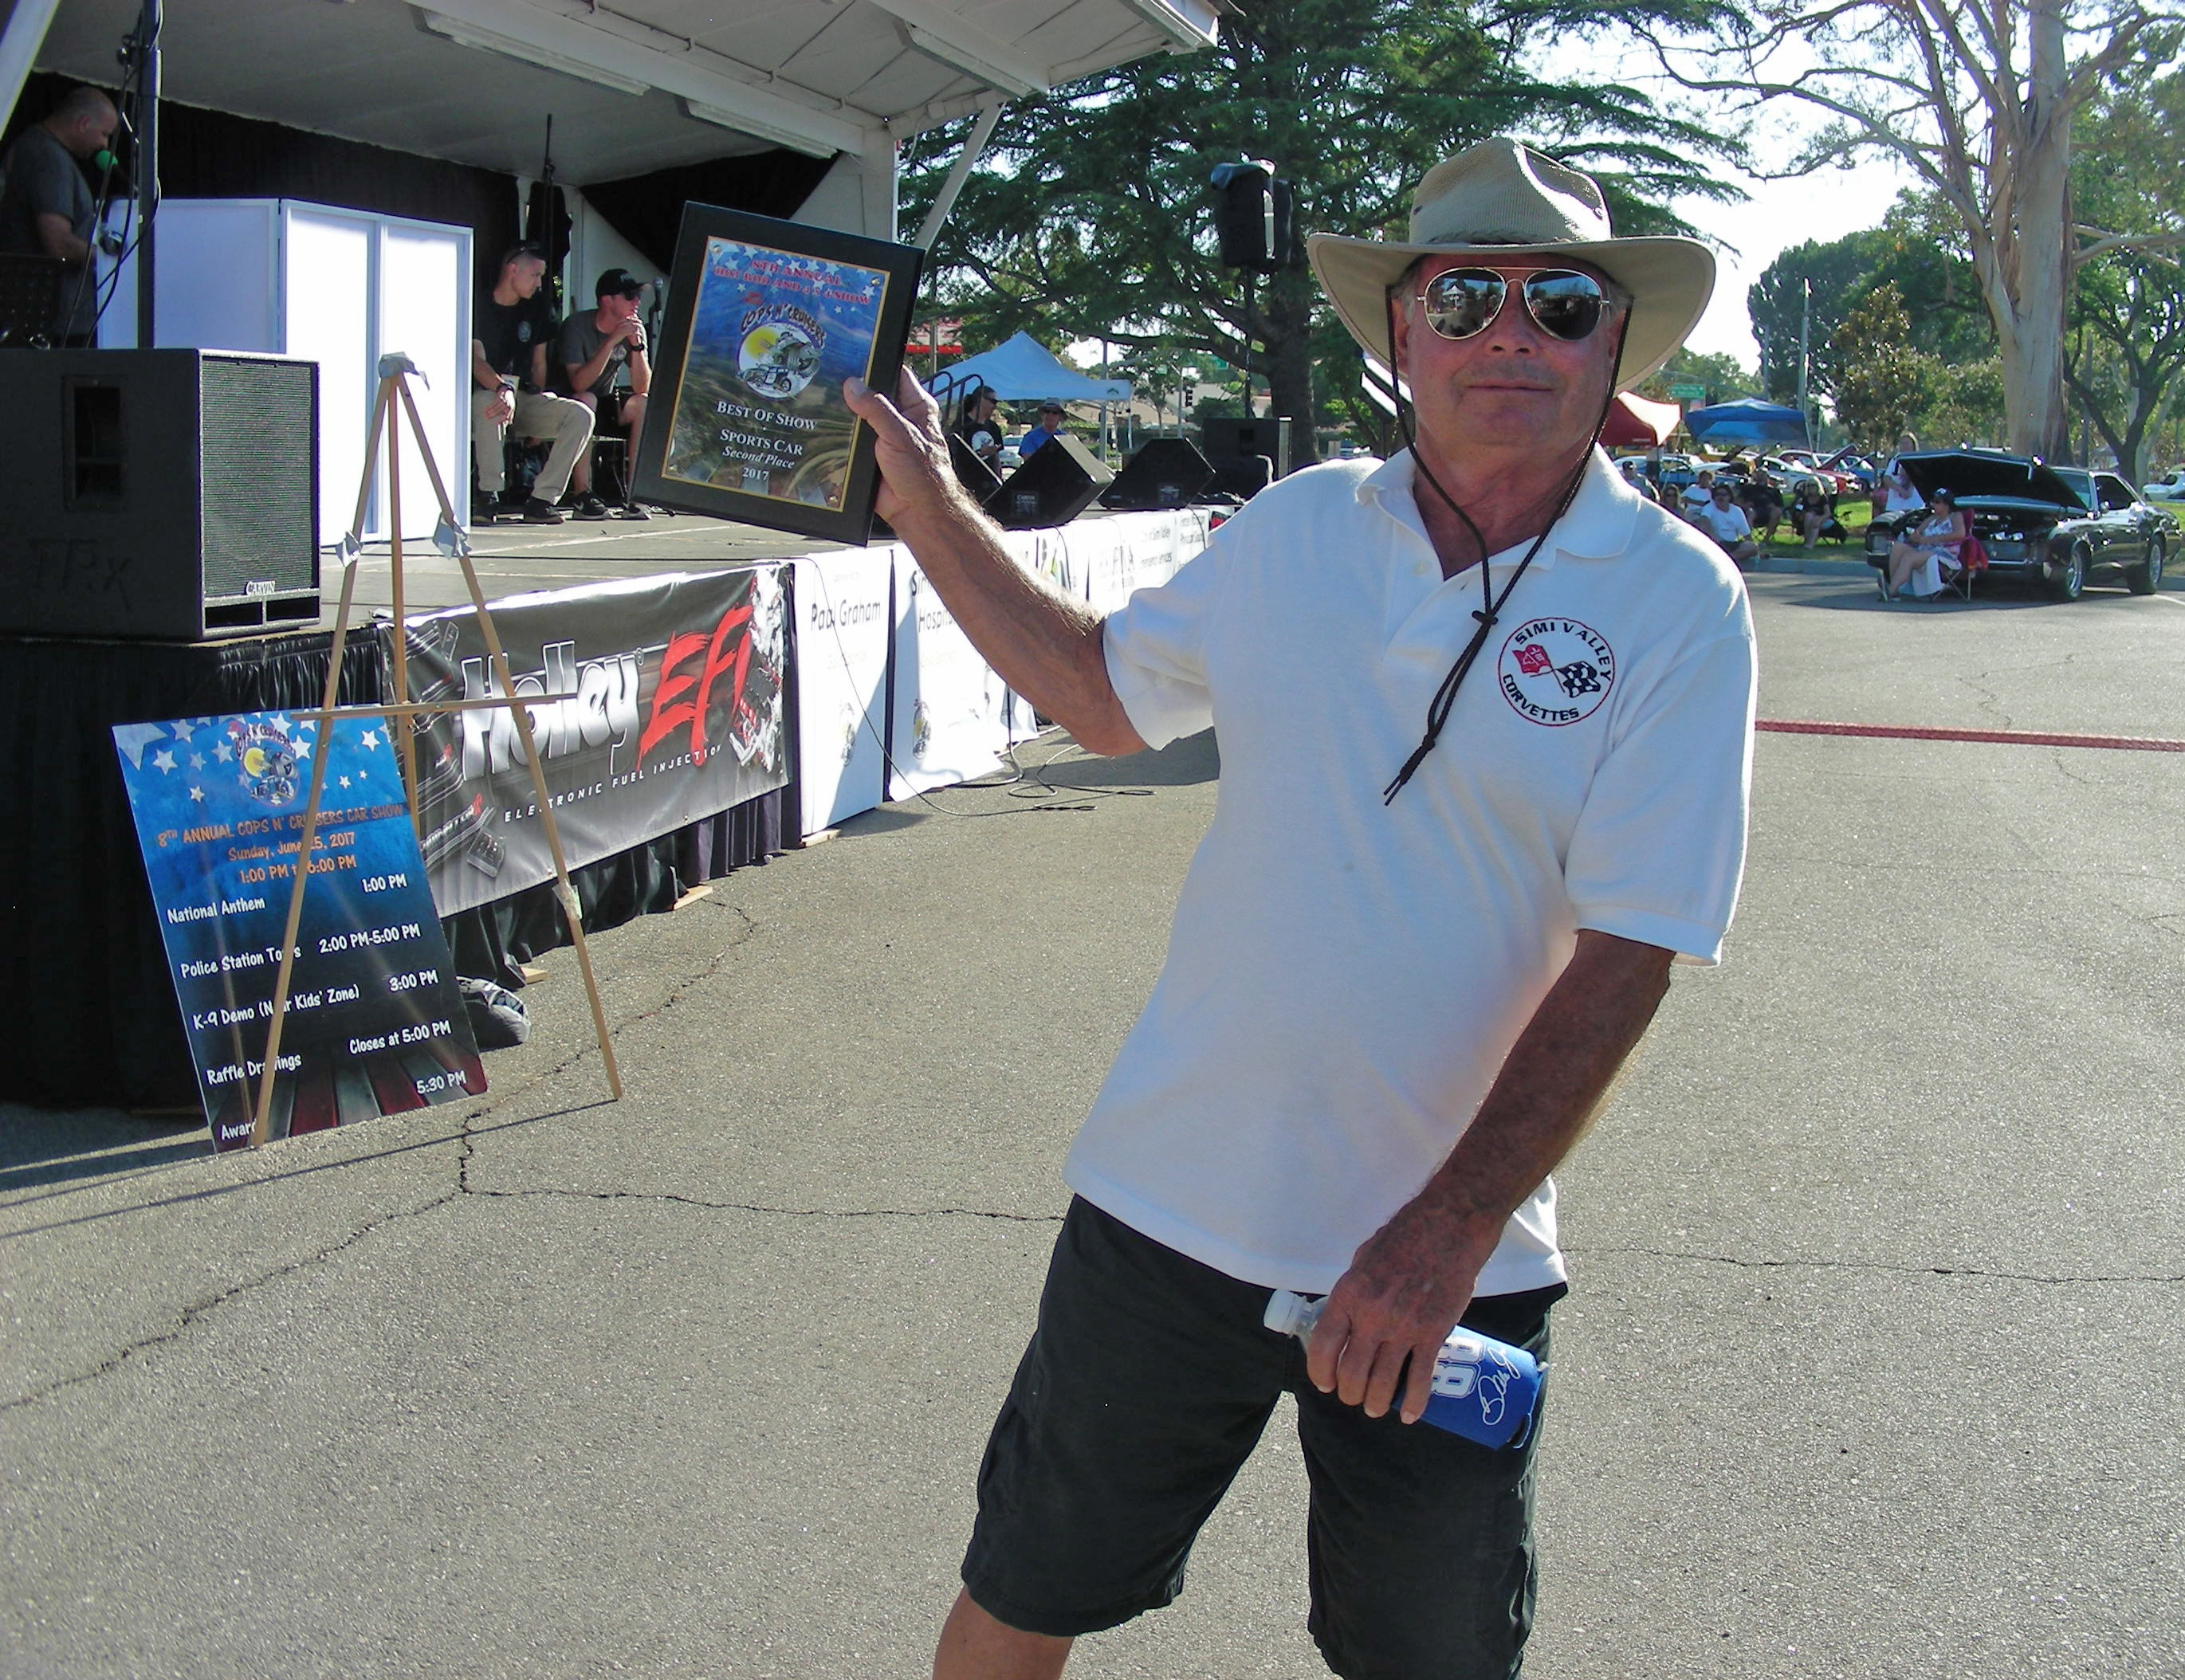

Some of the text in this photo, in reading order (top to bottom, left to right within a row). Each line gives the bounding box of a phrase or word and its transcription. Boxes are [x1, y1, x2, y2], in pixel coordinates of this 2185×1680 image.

[741, 304, 774, 336] COPS
[788, 304, 827, 350] CRUISERS
[717, 401, 818, 430] BEST OF SHOW
[720, 429, 804, 456] SPORTS CAR
[722, 446, 796, 469] Second Place
[742, 466, 770, 482] 2017
[246, 580, 276, 596] CARVIN
[839, 599, 882, 627] Graham
[918, 606, 958, 634] Hospita
[1515, 622, 1612, 681] SIMI VALLEY
[461, 640, 640, 782] Holley
[1503, 673, 1580, 722] CORVETTES
[504, 782, 603, 823] ELETRONIC
[611, 768, 646, 789] FUEL
[183, 823, 235, 844] ANNUAL
[237, 818, 269, 836] COPS
[289, 810, 344, 830] CRSERS
[347, 807, 369, 822] CAR
[370, 804, 403, 819] SHOW
[228, 845, 275, 862] Sunday,
[329, 831, 356, 848] 2017
[239, 866, 266, 885] 1:00
[269, 863, 289, 881] PM
[307, 857, 336, 874] 6:00
[338, 854, 357, 870] PM
[361, 872, 407, 893] 1:00 PM
[167, 895, 266, 924] National Anthem
[319, 922, 422, 954] 2:00 PM-5:00 PM
[180, 945, 302, 979] Police Station Tos
[388, 968, 439, 992] 3:00 PM
[192, 1011, 219, 1030] K-9
[221, 1006, 255, 1024] Demo
[294, 990, 324, 1011] Kids'
[327, 983, 360, 1004] Zone)
[349, 1019, 452, 1055] Closes at 5:00 PM
[206, 1064, 246, 1085] Raffle
[415, 1070, 466, 1094] 5:30 PM
